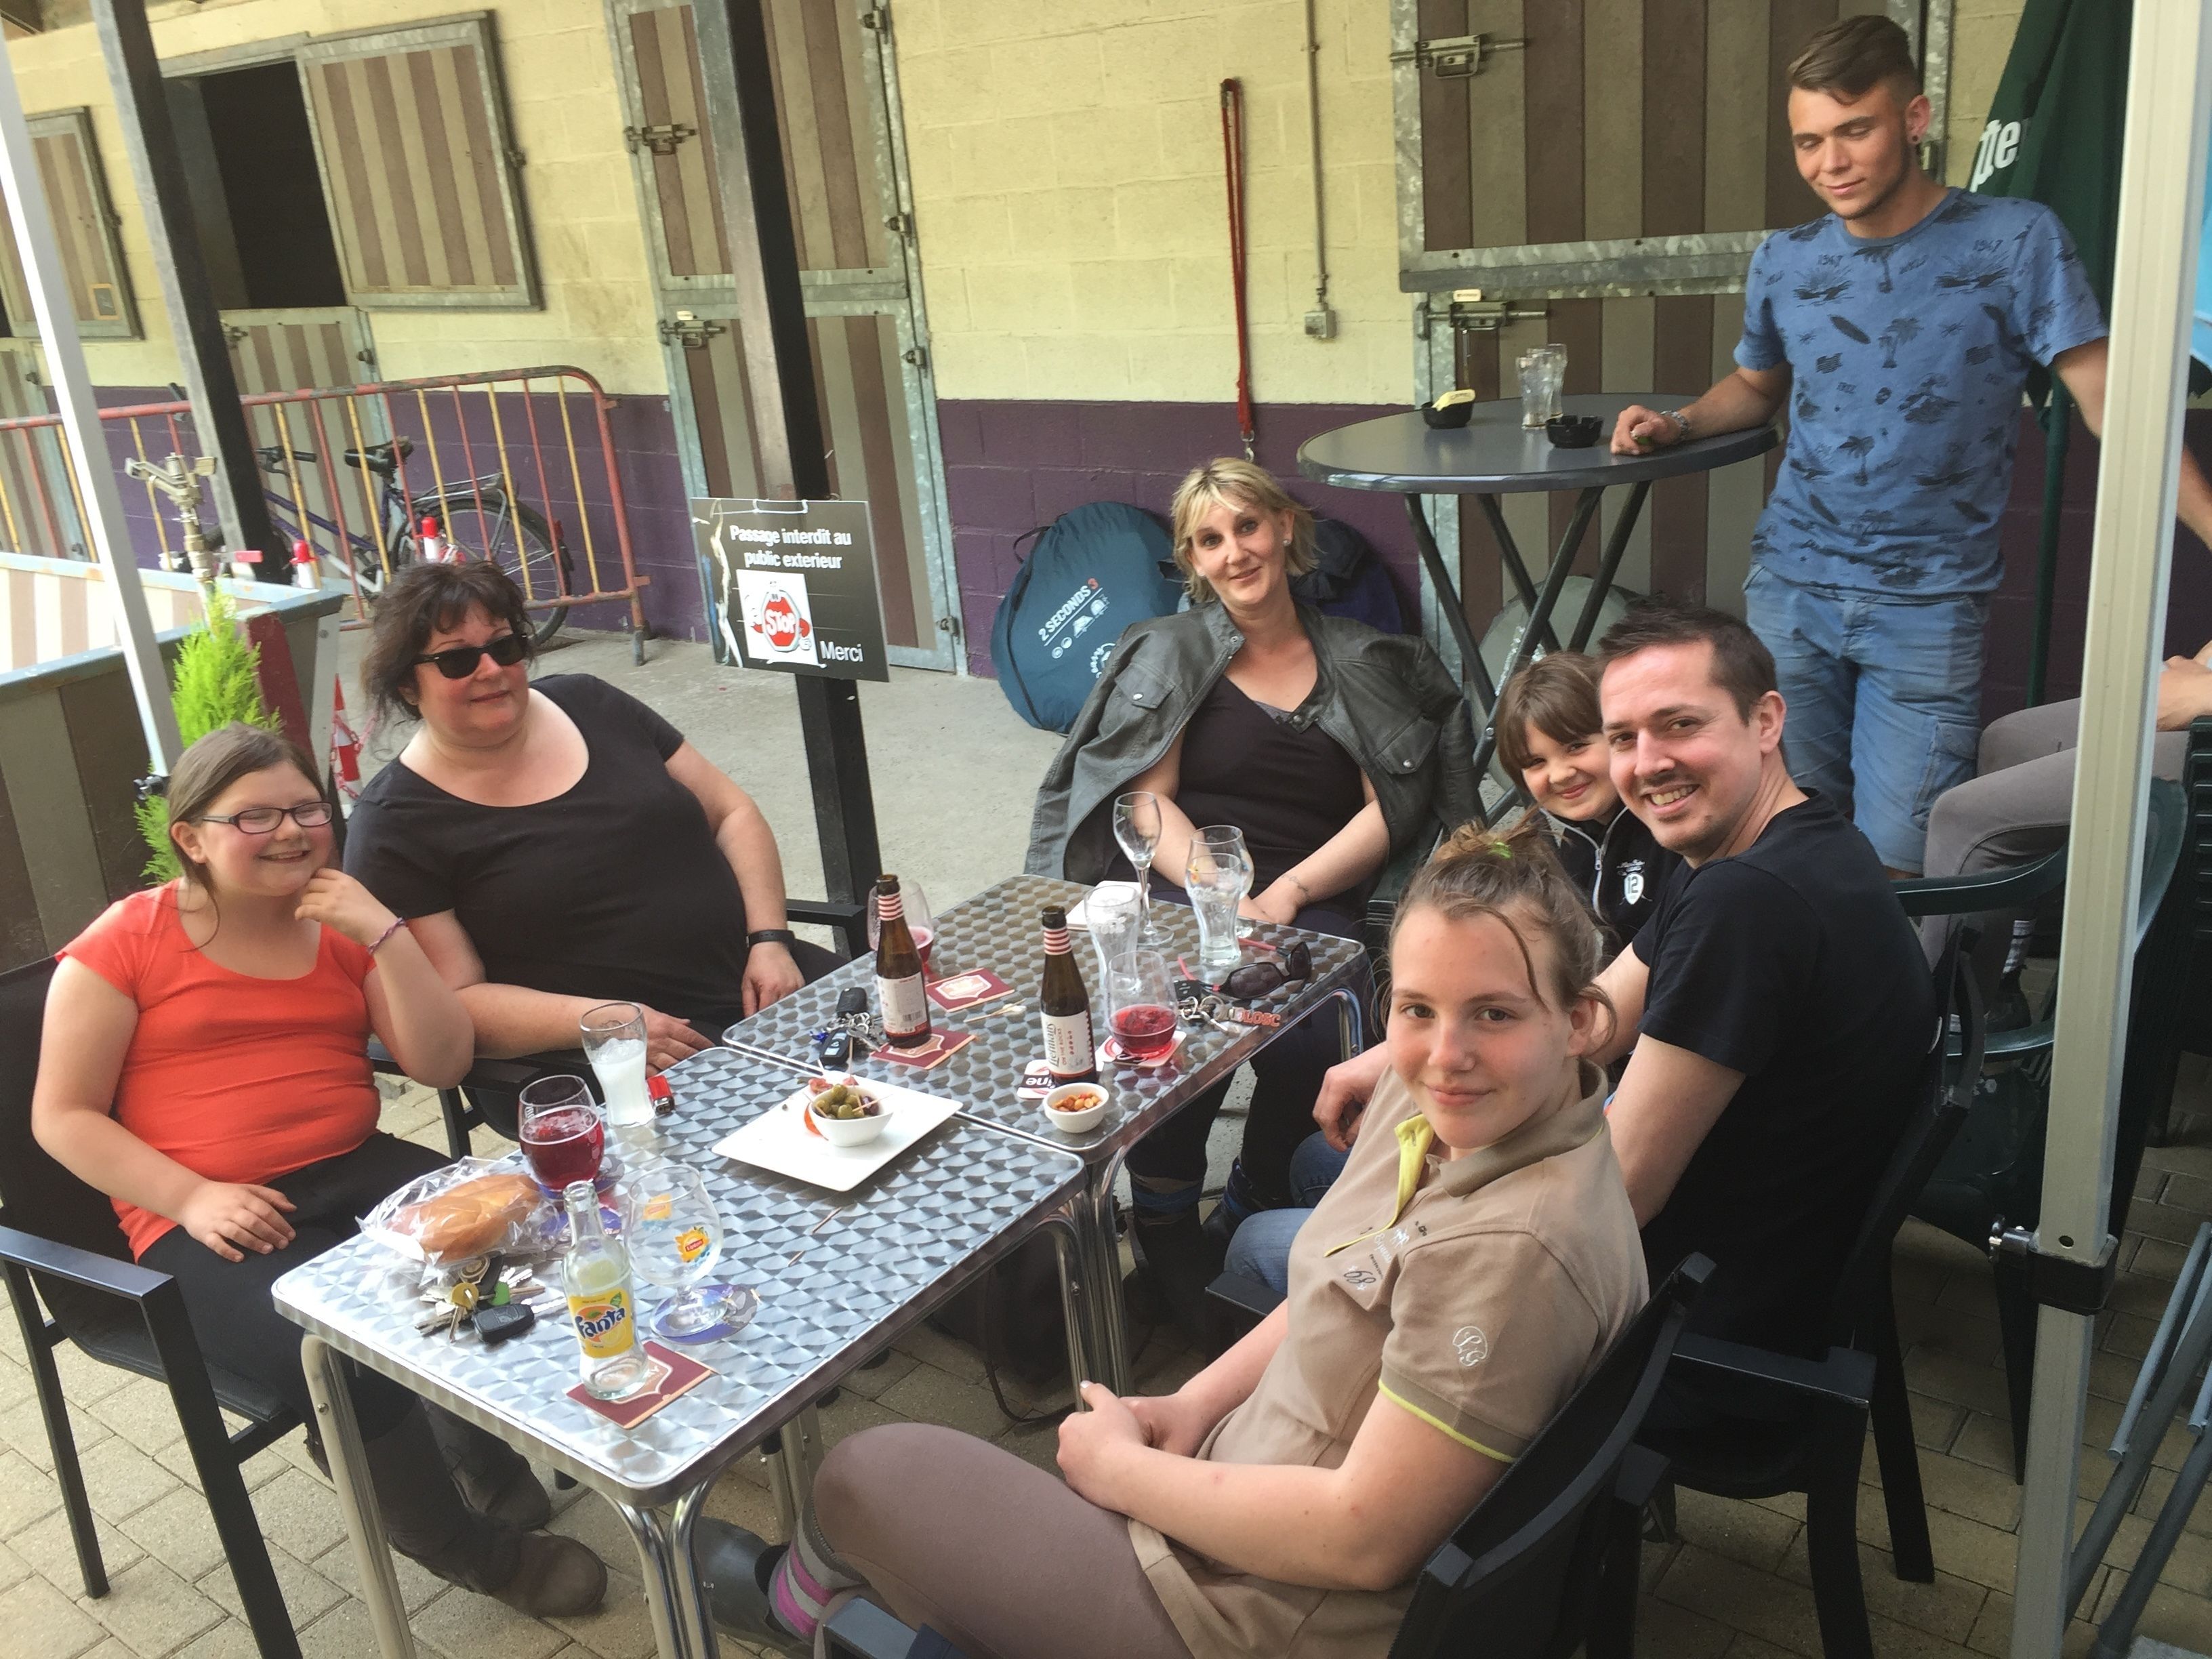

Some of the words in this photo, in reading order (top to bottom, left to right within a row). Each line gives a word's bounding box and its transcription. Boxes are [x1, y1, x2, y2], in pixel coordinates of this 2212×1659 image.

[729, 525, 780, 547] Passage
[781, 528, 832, 545] interdit
[833, 531, 852, 546] au
[743, 550, 781, 568] public
[783, 552, 842, 569] exterieur
[1038, 628, 1050, 641] 2
[1044, 586, 1092, 634] SECONDS
[820, 640, 863, 662] Merci
[1627, 876, 1639, 895] 12
